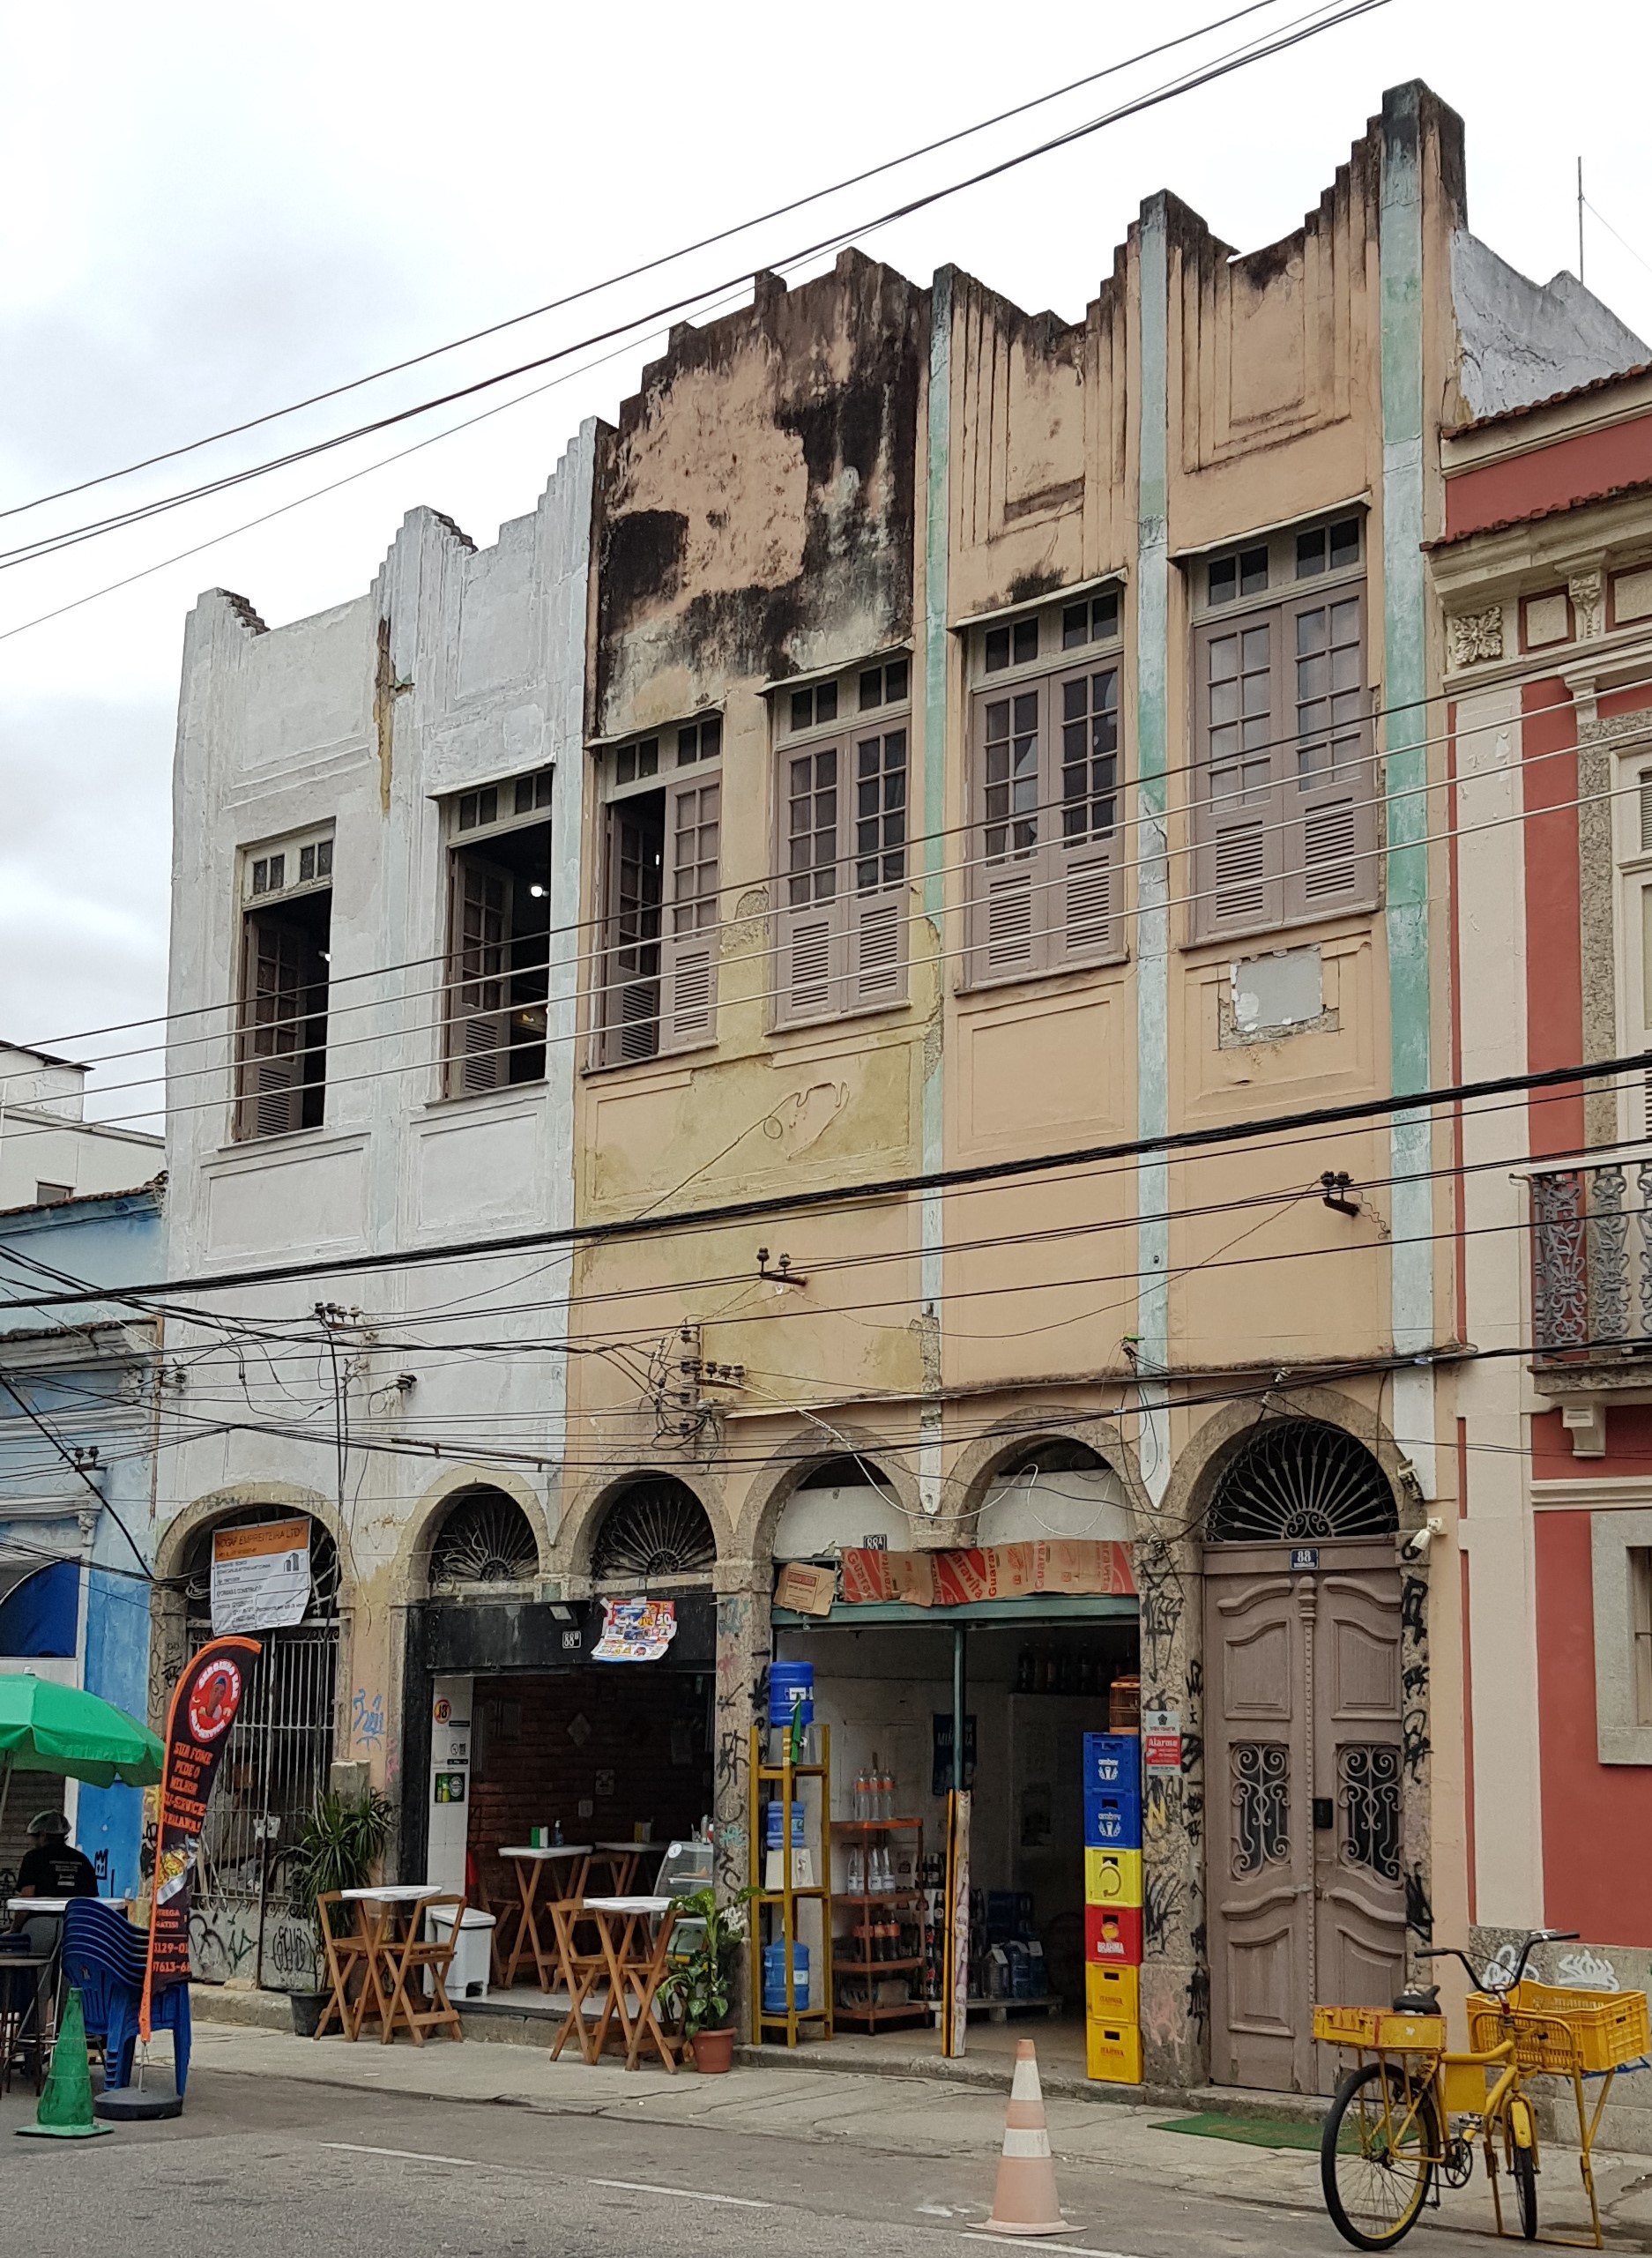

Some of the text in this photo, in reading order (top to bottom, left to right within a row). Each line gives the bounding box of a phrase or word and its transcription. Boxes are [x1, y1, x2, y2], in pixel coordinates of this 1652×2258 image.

[1297, 1550, 1312, 1562] 88
[1148, 1738, 1179, 1748] Alarme
[1097, 1941, 1125, 1955] BRAHMA
